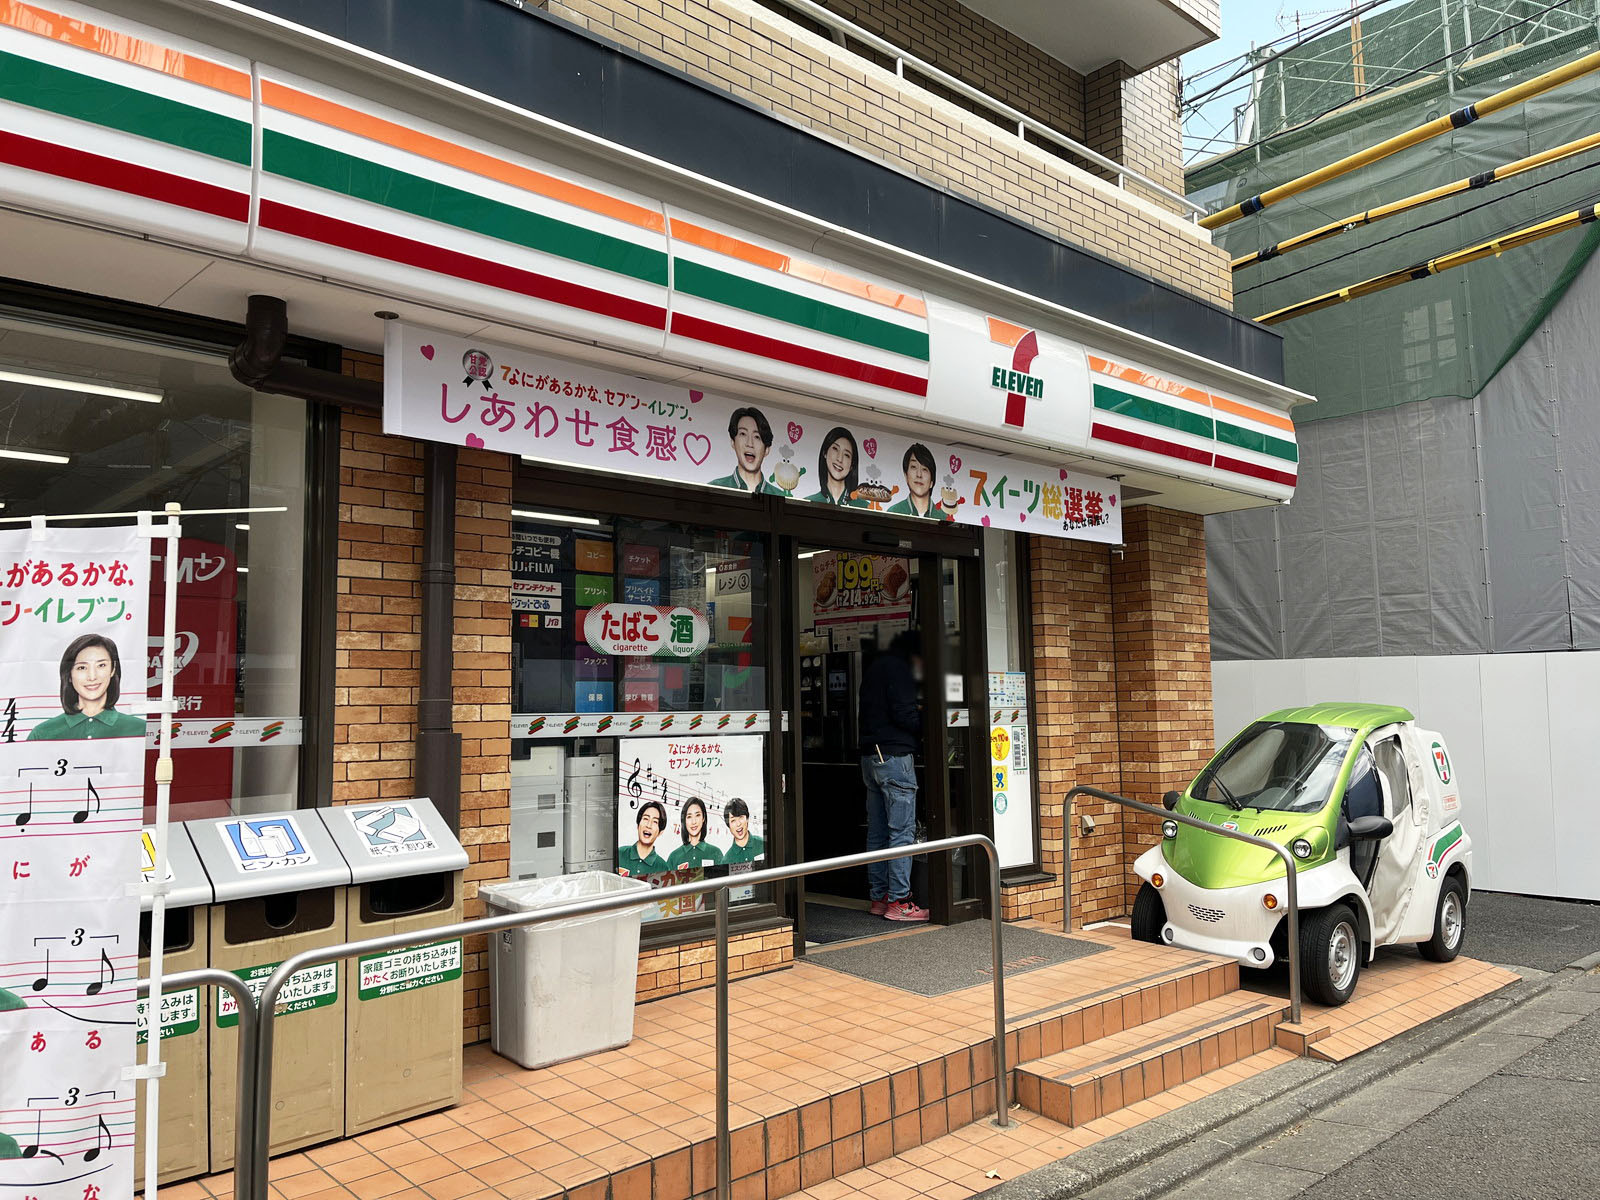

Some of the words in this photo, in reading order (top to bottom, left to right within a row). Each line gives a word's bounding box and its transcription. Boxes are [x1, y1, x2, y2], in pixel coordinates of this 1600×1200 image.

[969, 469, 1104, 525] スイーツ総選挙
[586, 551, 605, 559] コピー
[628, 556, 651, 564] チケット
[584, 587, 608, 596] プリント
[628, 593, 653, 602] サービス
[601, 609, 659, 642] たばこ
[670, 613, 694, 644] 酒
[612, 643, 649, 653] cigarette
[672, 644, 695, 654] liquor
[13, 861, 31, 880] に
[69, 856, 90, 877] が
[363, 945, 458, 975] 家庭ゴミの持ち込みは
[31, 1031, 47, 1052] あ
[85, 1030, 102, 1049] る
